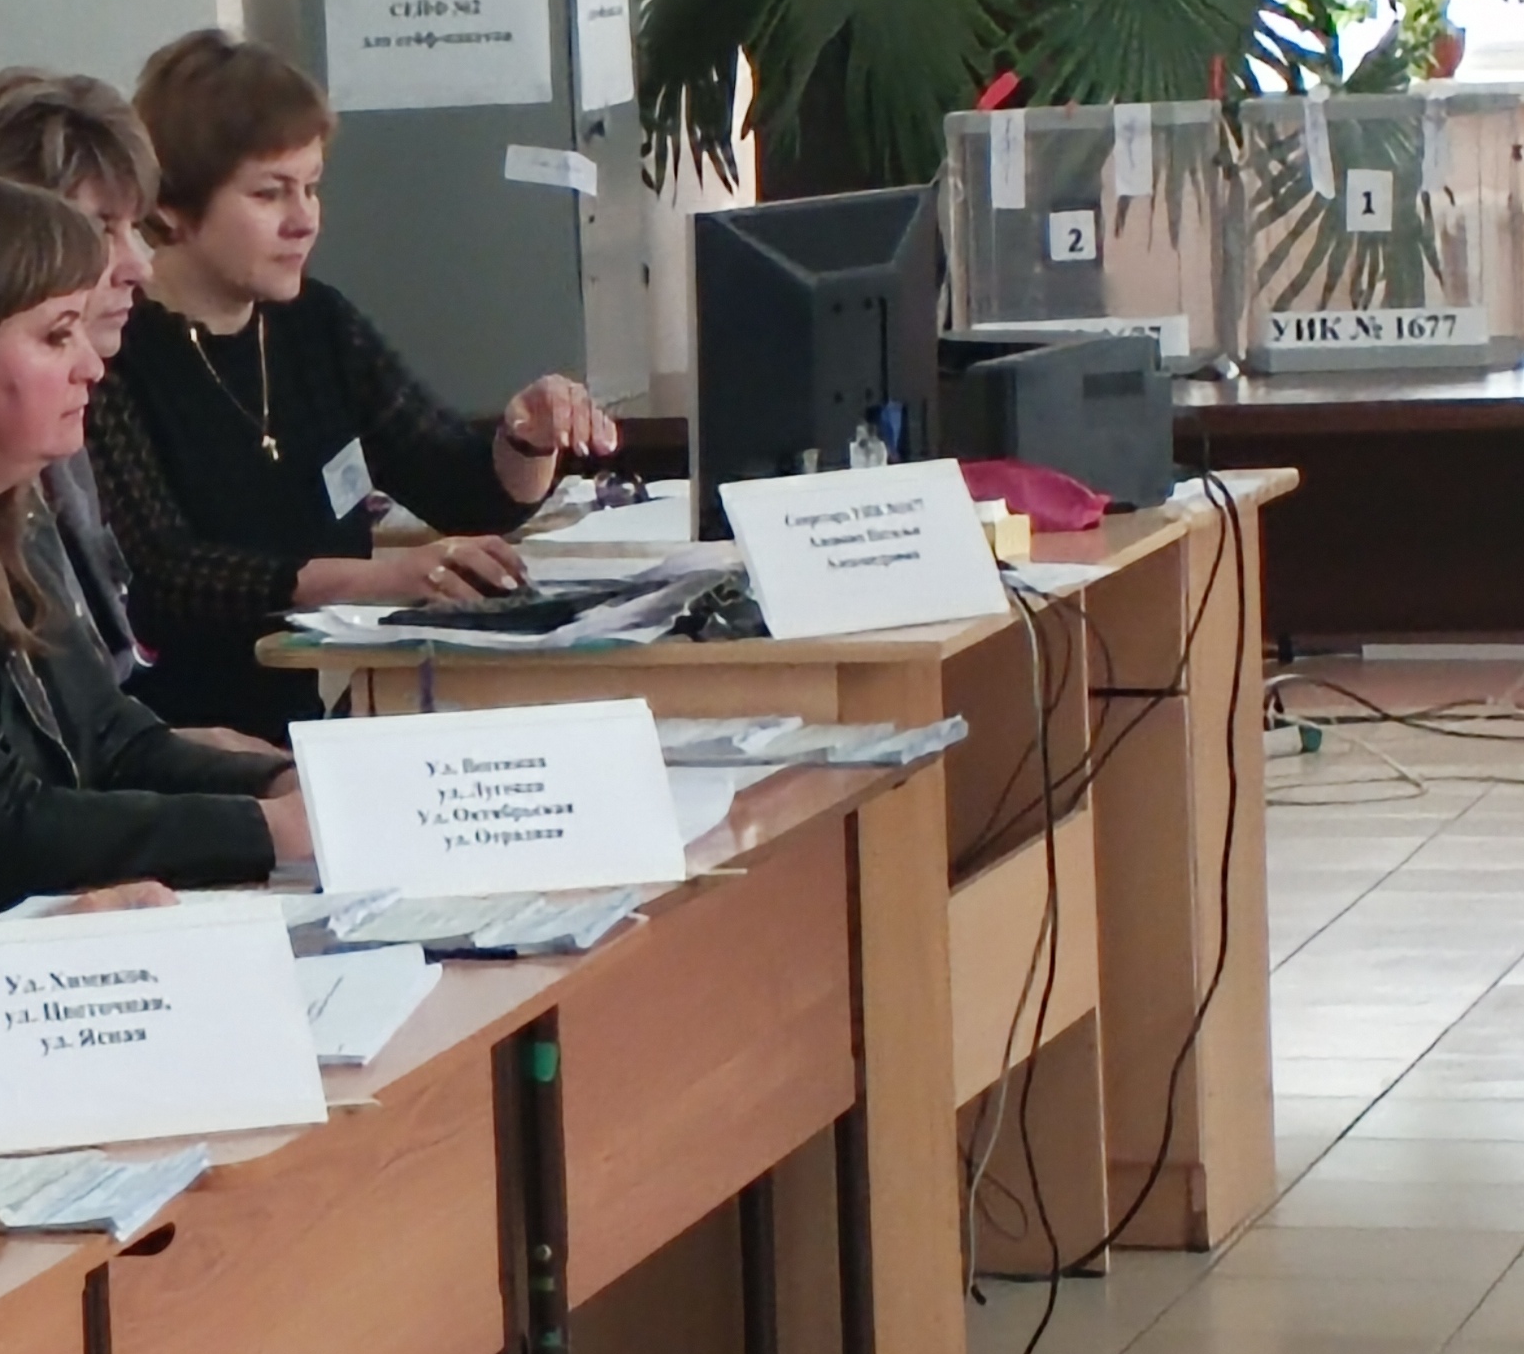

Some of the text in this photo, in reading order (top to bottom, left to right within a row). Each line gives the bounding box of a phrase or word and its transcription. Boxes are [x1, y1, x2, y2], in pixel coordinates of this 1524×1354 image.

[1361, 190, 1375, 215] 1
[1067, 227, 1084, 253] 2
[1270, 314, 1457, 342] УИК № 1677
[40, 1034, 74, 1057] ул.
